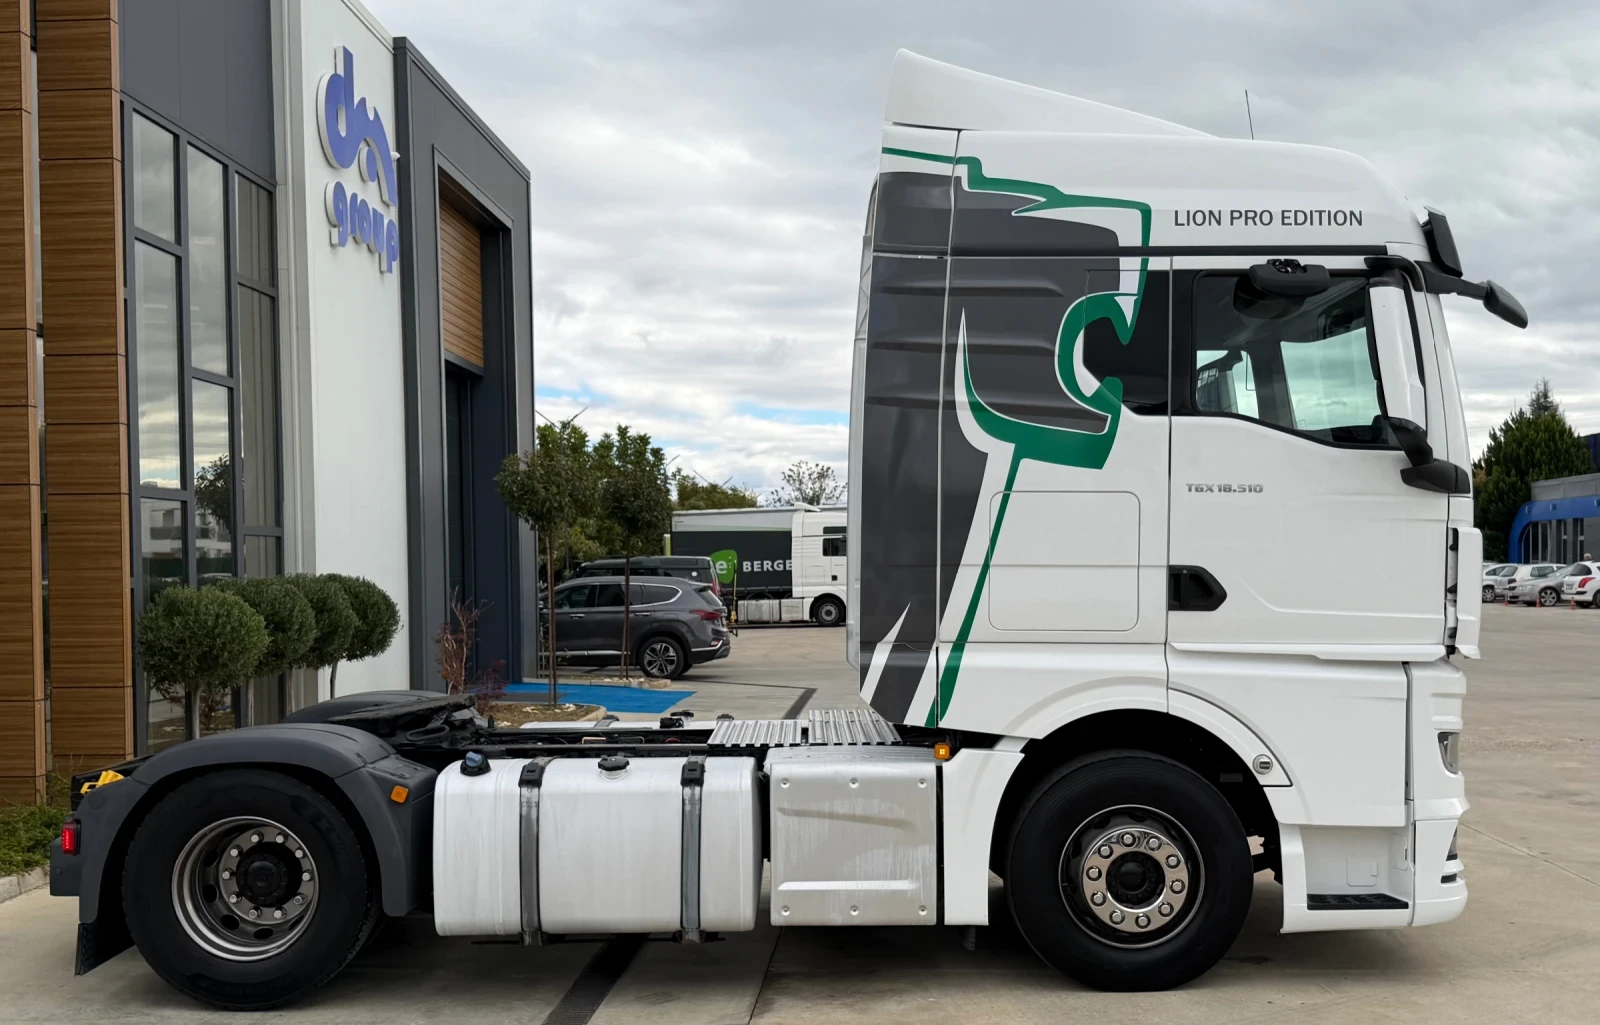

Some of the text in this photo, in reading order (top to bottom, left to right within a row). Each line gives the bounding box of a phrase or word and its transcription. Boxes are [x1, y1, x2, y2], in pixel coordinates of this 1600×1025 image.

[327, 180, 399, 274] group
[1174, 209, 1364, 227] LION PRO EDITION
[1216, 483, 1264, 493] 18.510
